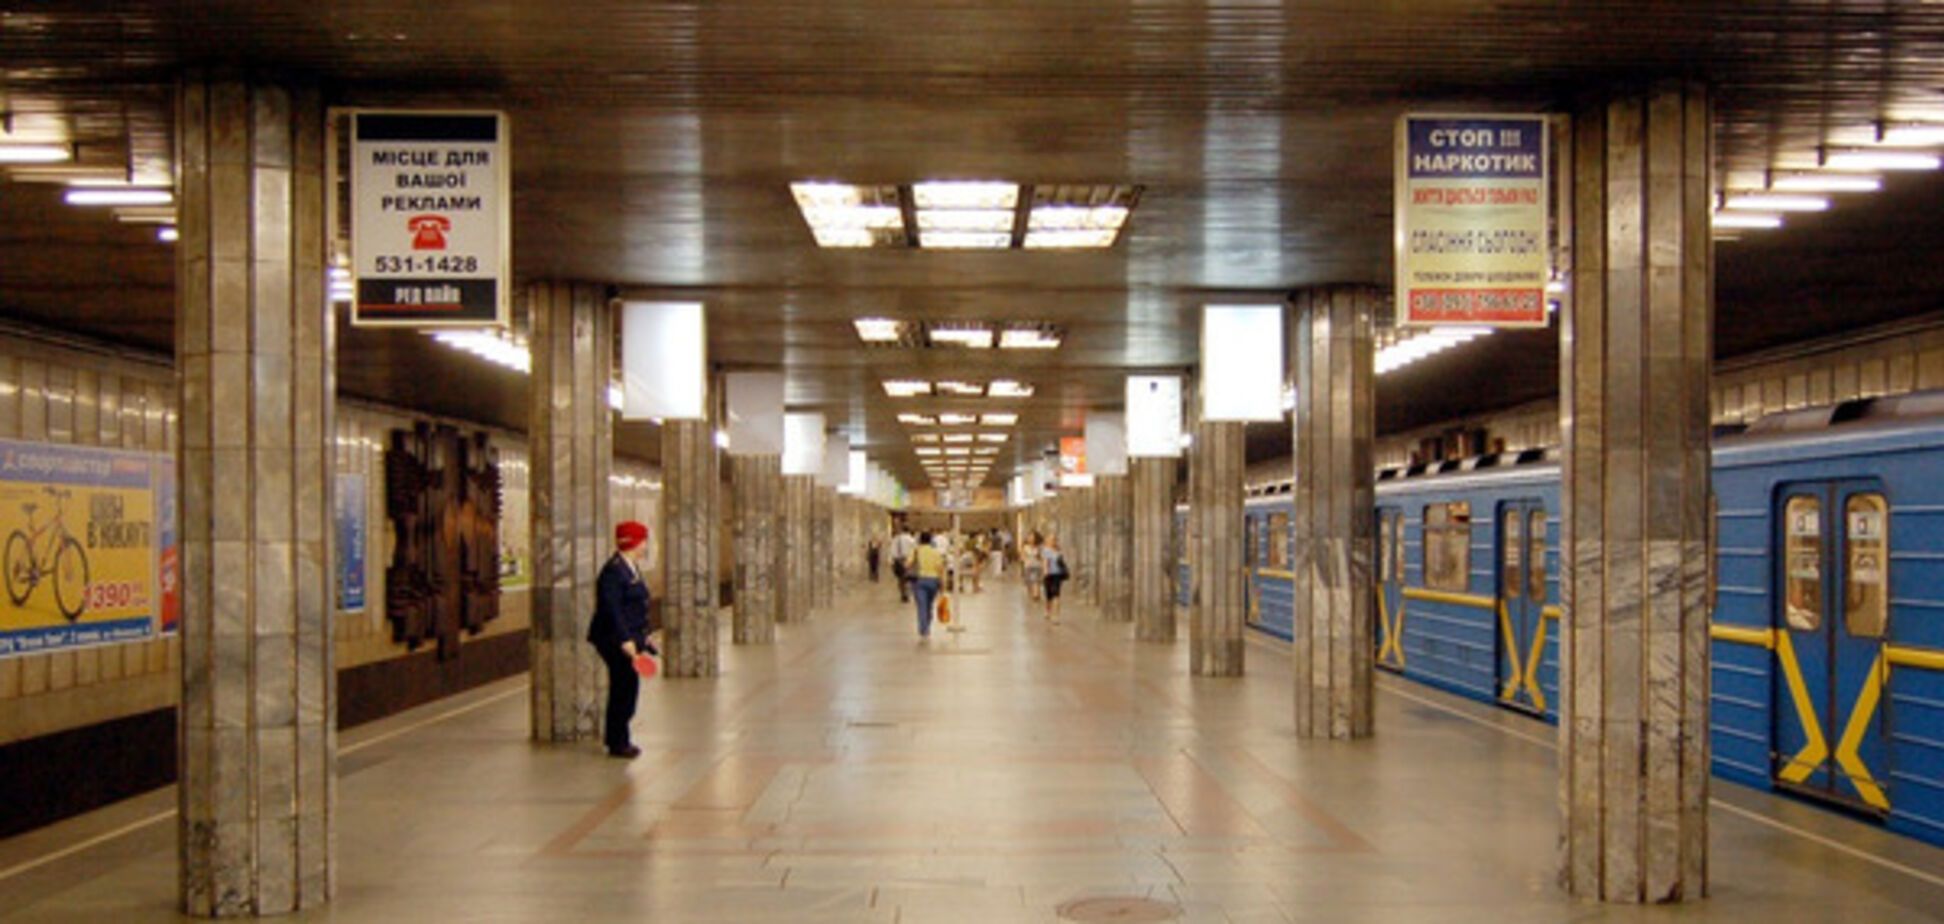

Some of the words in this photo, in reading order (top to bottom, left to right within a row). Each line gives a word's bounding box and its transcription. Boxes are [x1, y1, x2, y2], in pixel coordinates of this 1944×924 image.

[1429, 129, 1494, 147] СТОП
[372, 151, 439, 167] МІСЦЕ
[445, 151, 490, 167] ДЛЯ
[1414, 155, 1535, 171] НАРКОТИК
[395, 173, 466, 188] ВАШОЇ
[381, 197, 482, 211] РЕКЛАМИ
[376, 256, 478, 272] 531-1428
[83, 583, 131, 608] 1390
